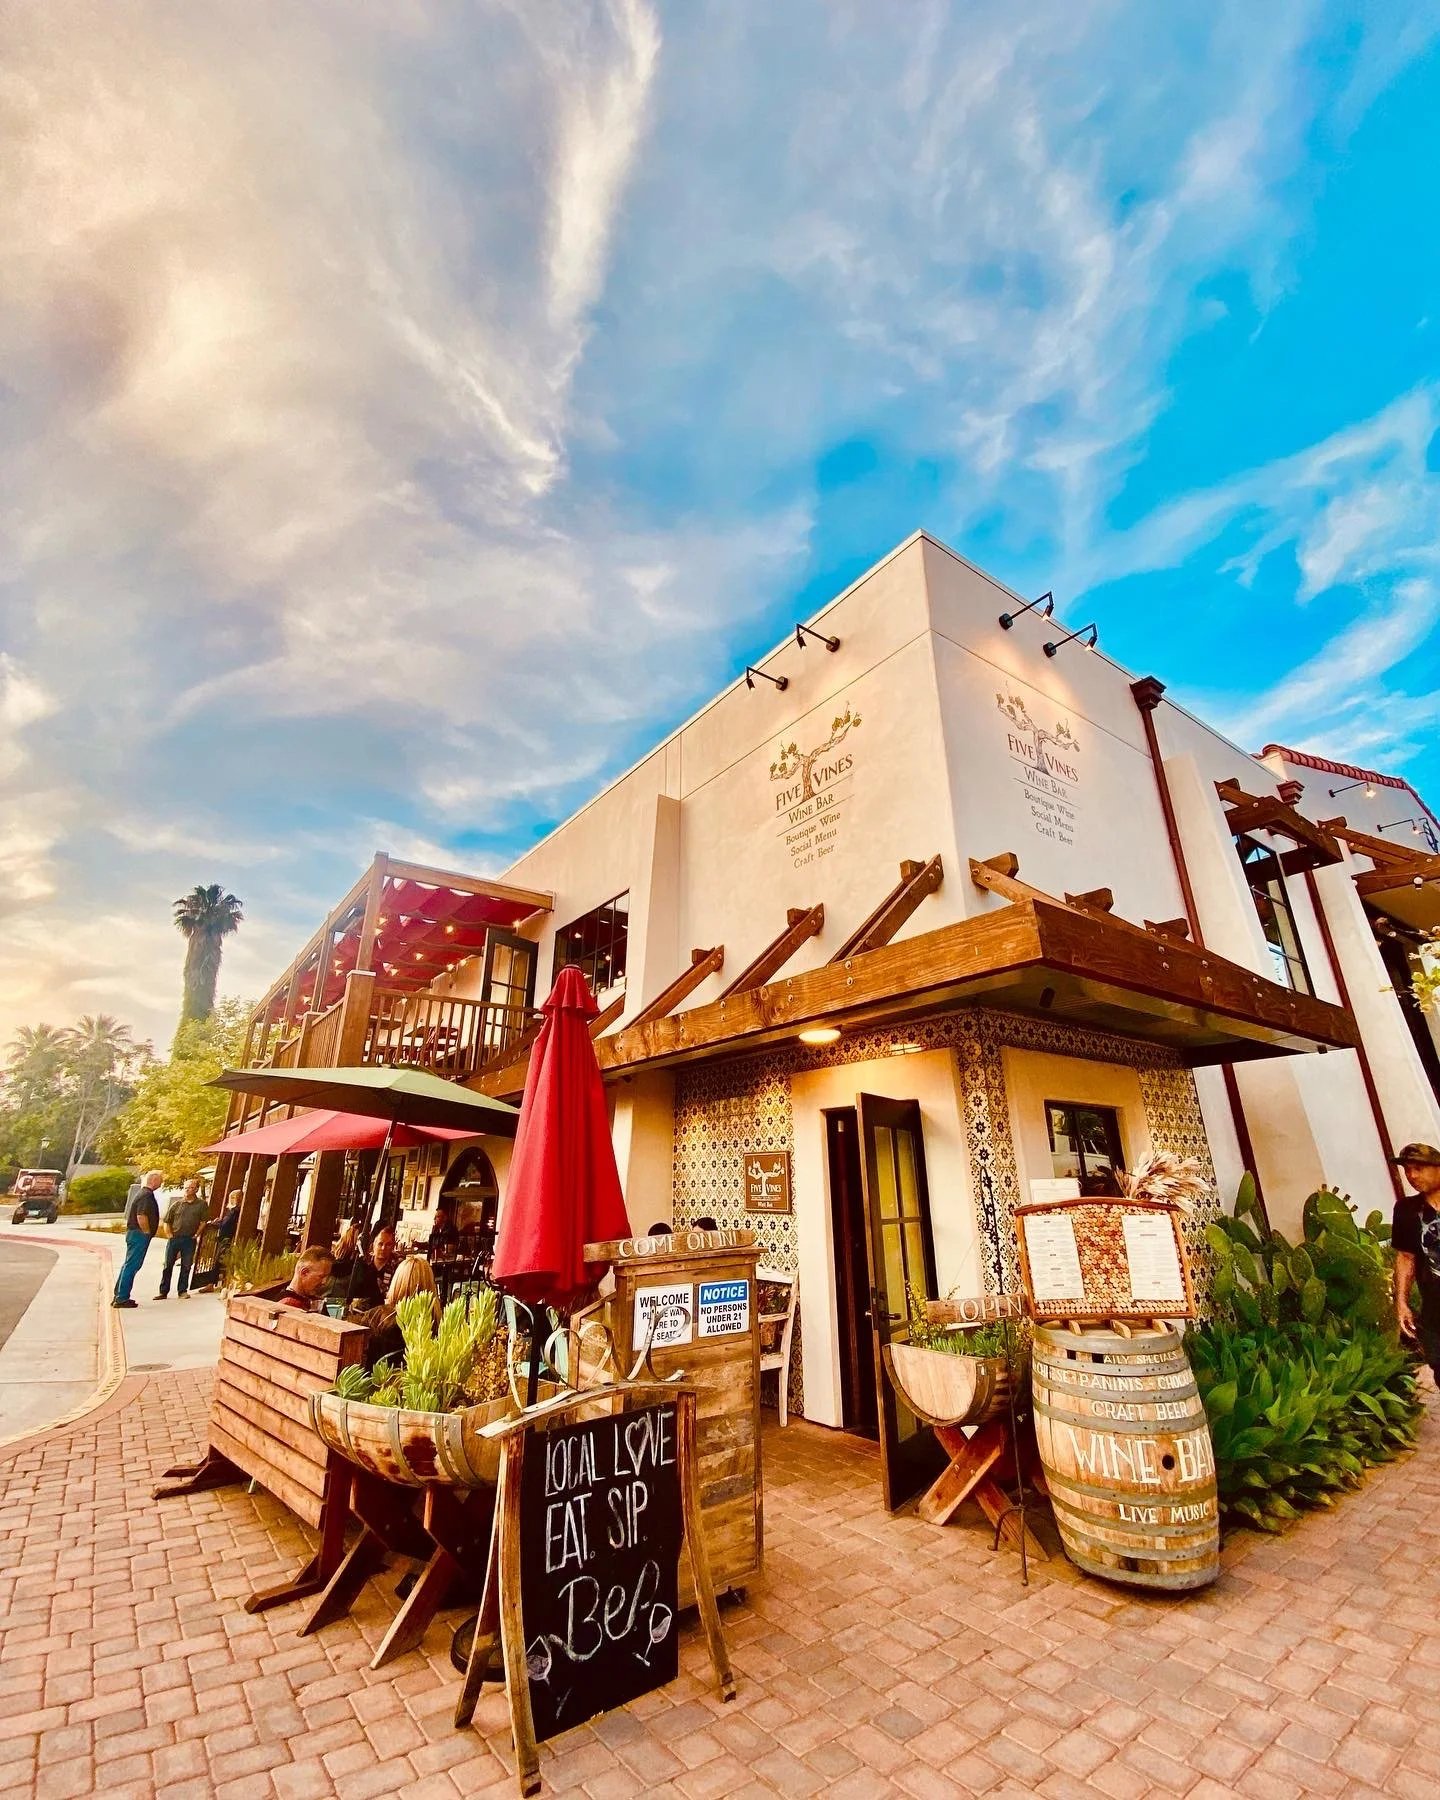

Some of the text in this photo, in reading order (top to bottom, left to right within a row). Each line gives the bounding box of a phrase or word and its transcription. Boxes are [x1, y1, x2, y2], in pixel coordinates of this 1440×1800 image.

[1008, 733, 1079, 782] FIVE VINES
[776, 753, 854, 811] FIVE VINES
[1024, 766, 1049, 790] WINE
[788, 793, 834, 824] WINE BAR
[1023, 788, 1075, 820] Boutique Wine
[786, 812, 841, 846] Boutique Wine
[1031, 805, 1074, 833] Social Menu
[790, 828, 837, 858] Social Menu
[1035, 822, 1073, 846] Craft Beer
[793, 843, 835, 870] Craft Beer
[619, 1236, 677, 1258] COME
[687, 1232, 713, 1250] ON
[640, 1293, 689, 1308] WELCOME
[703, 1285, 745, 1301] NOTICE
[701, 1303, 747, 1315] NO PERSONS
[707, 1313, 742, 1324] UNDER 21
[960, 1296, 1022, 1321] OPEN
[670, 1320, 679, 1328] TO
[707, 1322, 742, 1333] ALLOWED
[1103, 1354, 1130, 1364] AILY
[1079, 1371, 1144, 1392] PANINIS
[1090, 1400, 1189, 1421] CRAFT BEER
[545, 1431, 606, 1497] LOCAL
[1067, 1427, 1161, 1484] WINE
[1119, 1502, 1209, 1524] LIVE MUSIC
